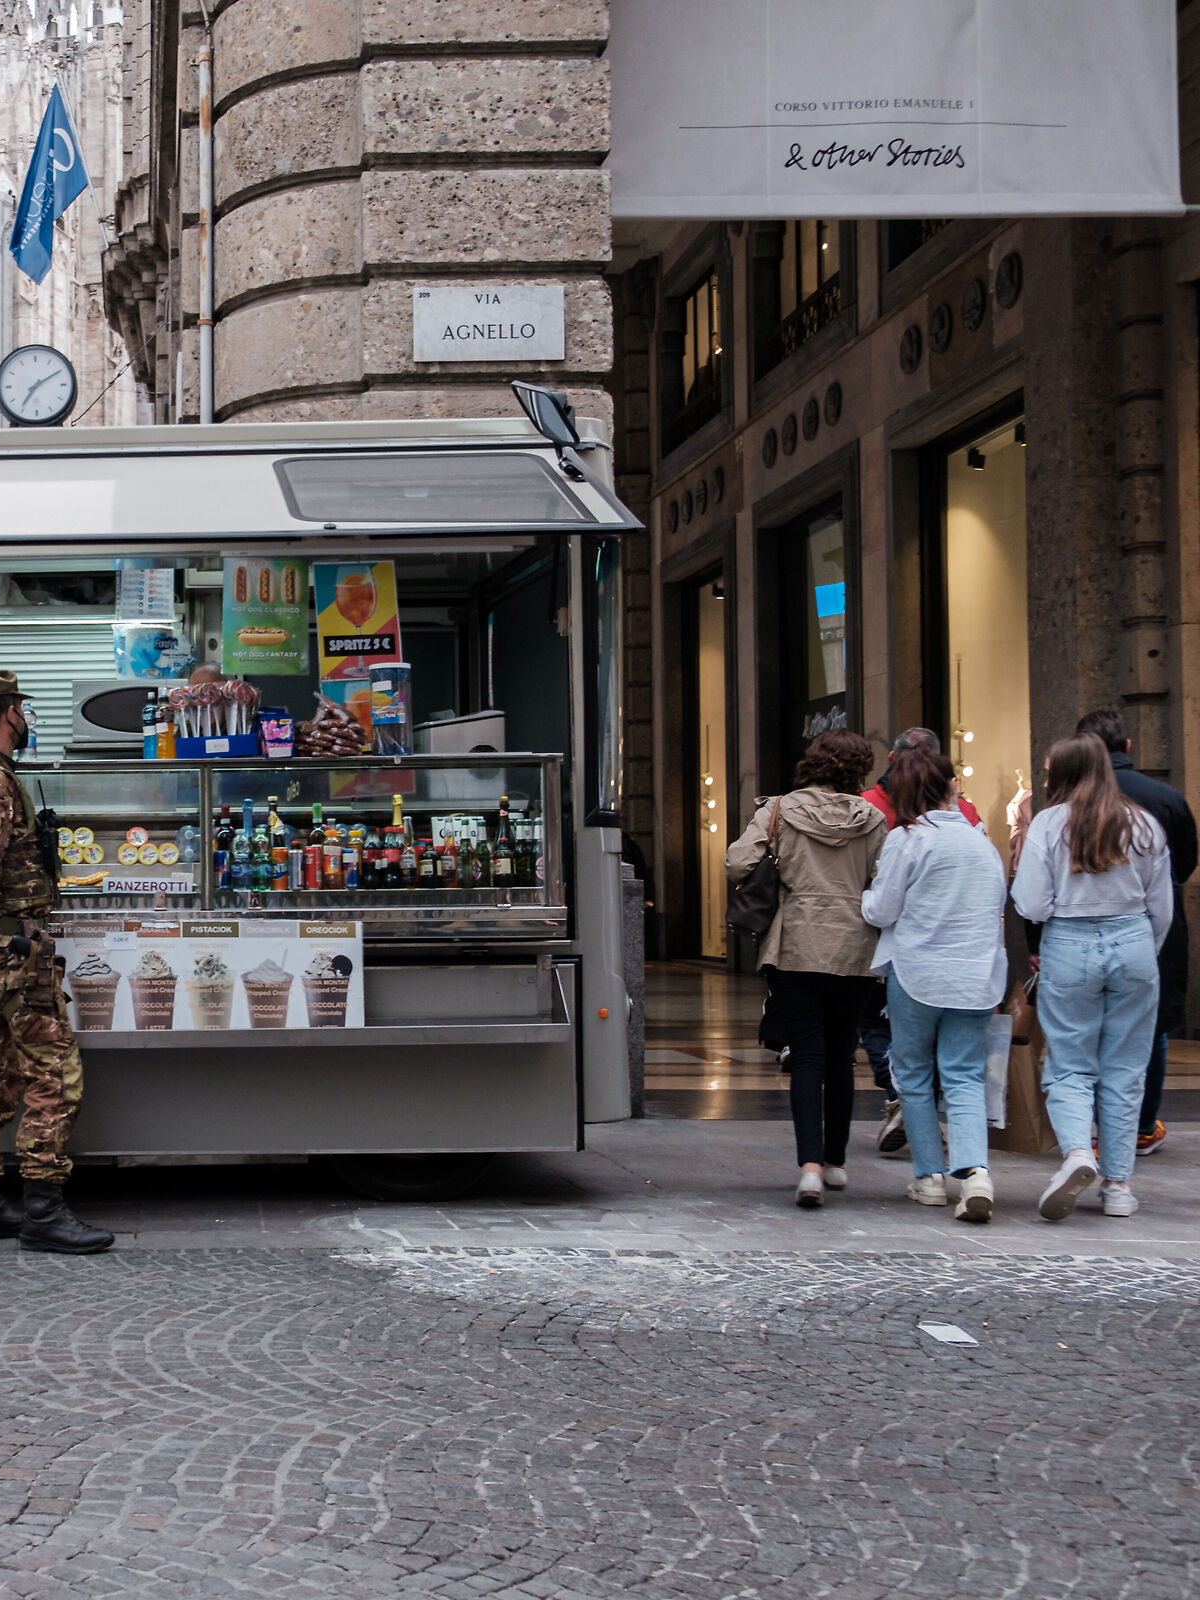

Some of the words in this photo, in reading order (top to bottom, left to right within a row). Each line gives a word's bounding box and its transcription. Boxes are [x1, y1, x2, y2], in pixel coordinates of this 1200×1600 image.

[774, 102, 817, 112] CORSO
[822, 98, 889, 111] VITTORIO
[893, 98, 964, 110] EMANUELE
[784, 143, 807, 171] &
[811, 141, 884, 170] other
[886, 138, 965, 169] Stories
[474, 294, 501, 304] VIA
[442, 323, 536, 340] AGNELLO
[329, 639, 371, 652] SPRITZ
[373, 639, 380, 650] 5
[382, 638, 391, 650] €
[107, 881, 188, 892] PANZEROTTI
[306, 926, 348, 934] OREOCIOK
